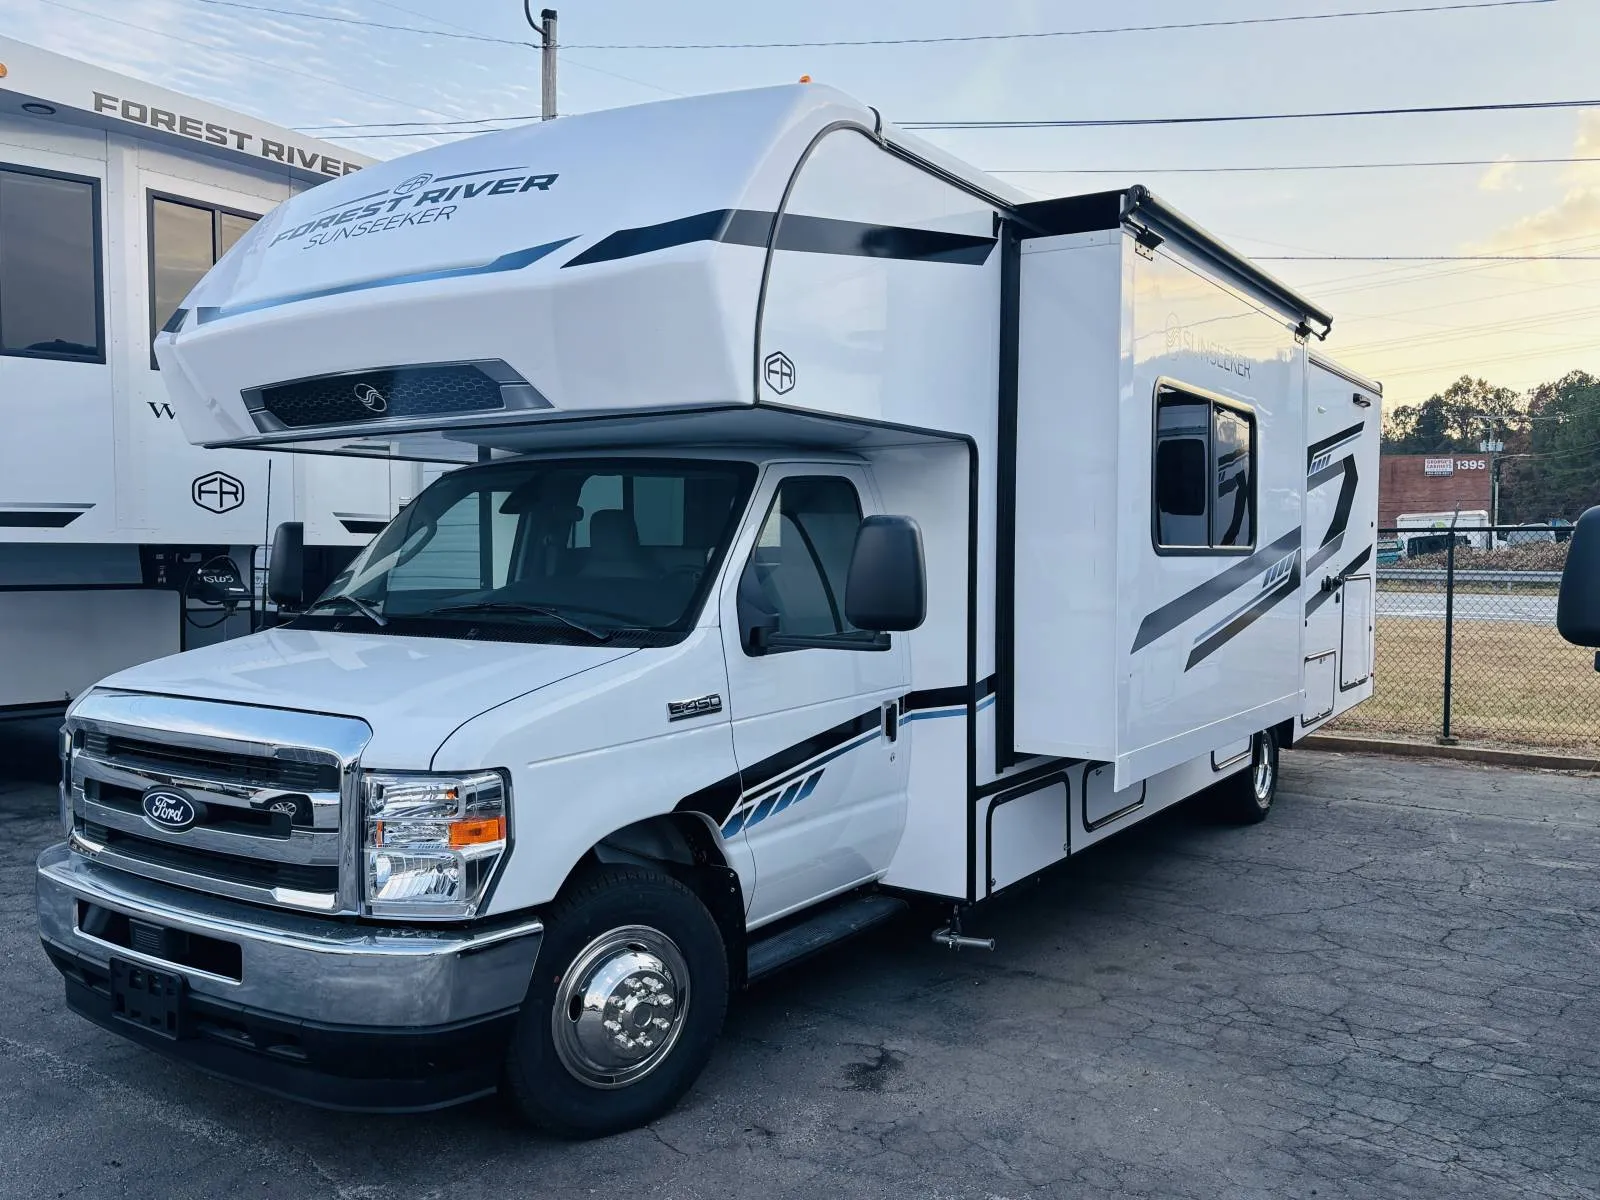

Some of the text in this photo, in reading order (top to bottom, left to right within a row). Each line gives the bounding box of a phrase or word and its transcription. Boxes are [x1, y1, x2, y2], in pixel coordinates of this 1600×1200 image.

[92, 91, 252, 150] FOREST
[268, 173, 560, 248] FOREST RIVER
[303, 204, 457, 250] SUNSEEKER
[1456, 460, 1486, 470] 1395
[152, 795, 184, 822] Ford
